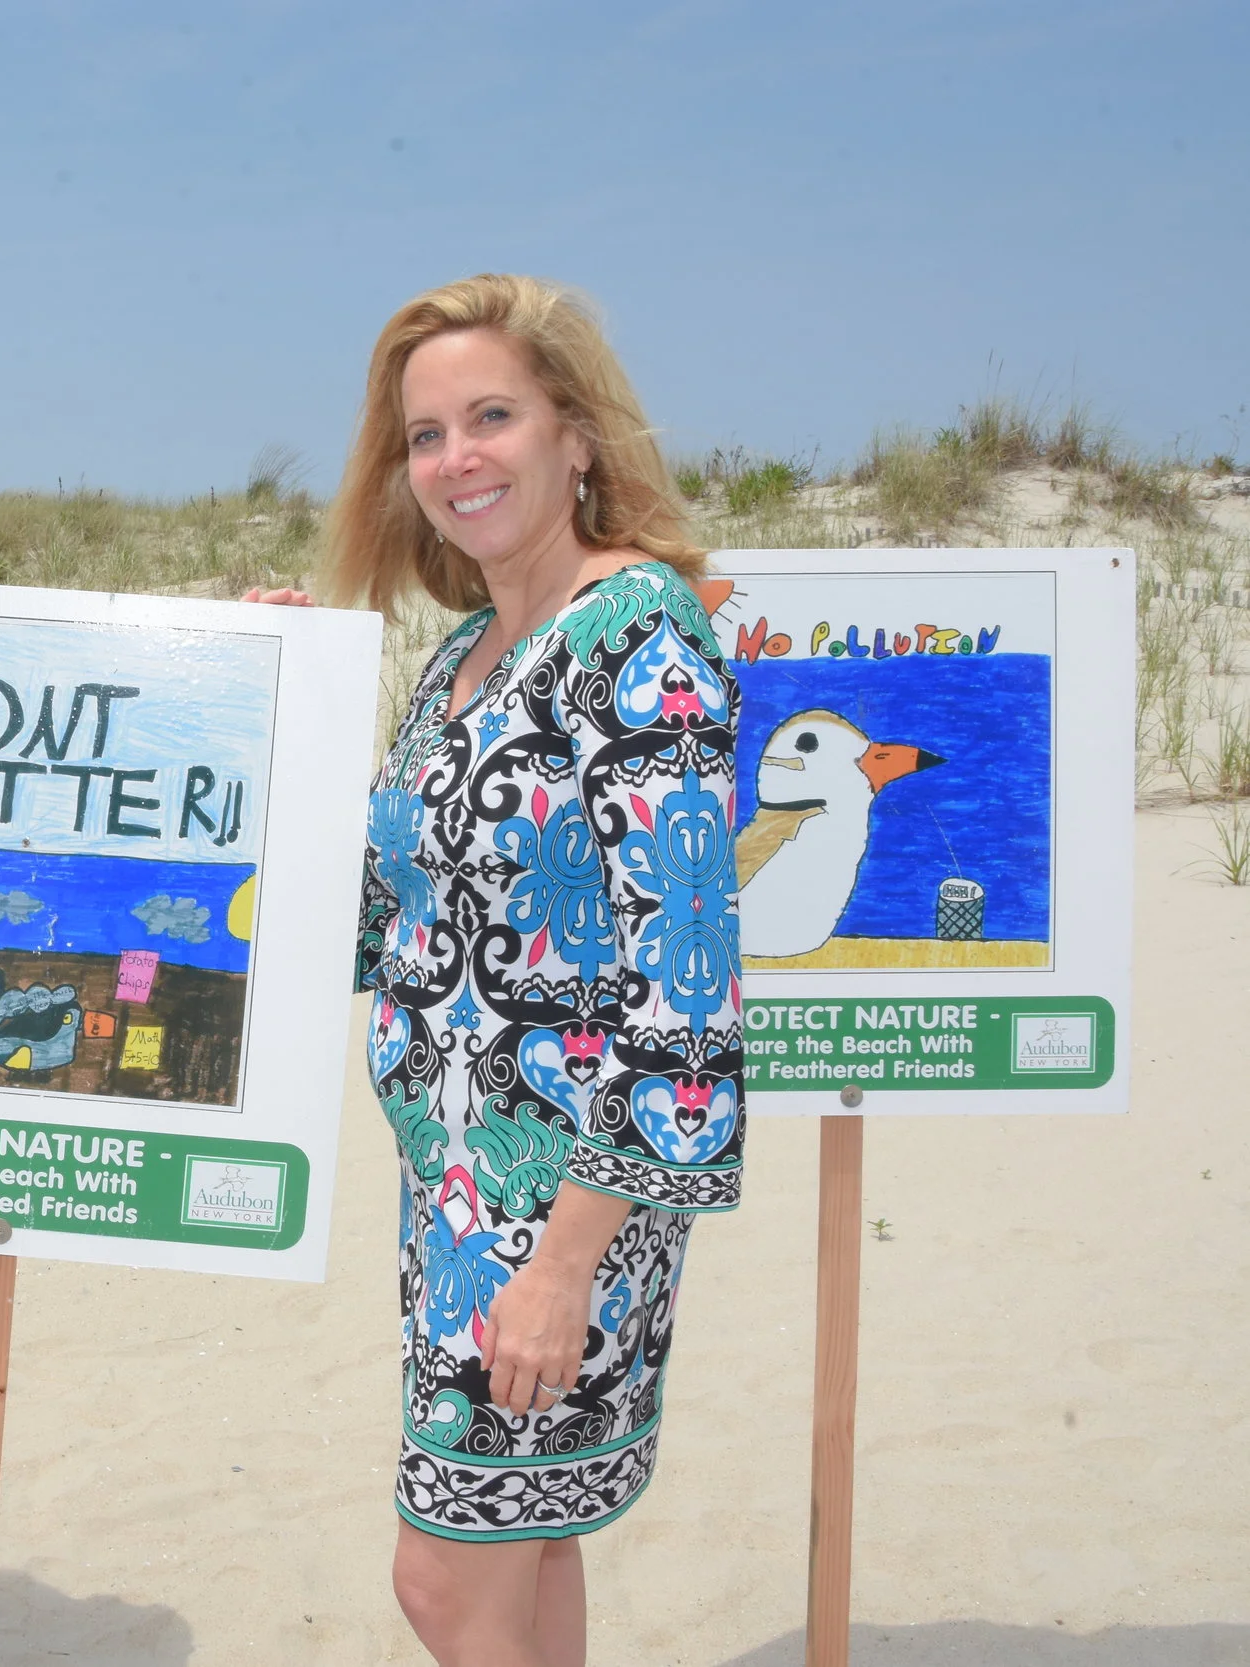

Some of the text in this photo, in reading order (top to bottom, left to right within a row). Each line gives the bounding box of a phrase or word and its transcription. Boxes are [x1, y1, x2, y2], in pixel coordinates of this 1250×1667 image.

[121, 949, 154, 968] Potato
[743, 1006, 843, 1030] OTECT
[856, 1005, 977, 1029] NATURE
[795, 1035, 833, 1054] the
[843, 1035, 911, 1054] Beach
[921, 1034, 972, 1054] With
[1021, 1040, 1087, 1055] Audubon
[769, 1059, 884, 1079] Feathered
[894, 1059, 974, 1079] Friends
[1019, 1059, 1046, 1067] NEW
[0, 1129, 145, 1168] NATURE
[75, 1169, 137, 1196] With
[193, 1188, 273, 1210] Audubon
[41, 1196, 138, 1225] Friends
[191, 1209, 273, 1224] NEW YORK
